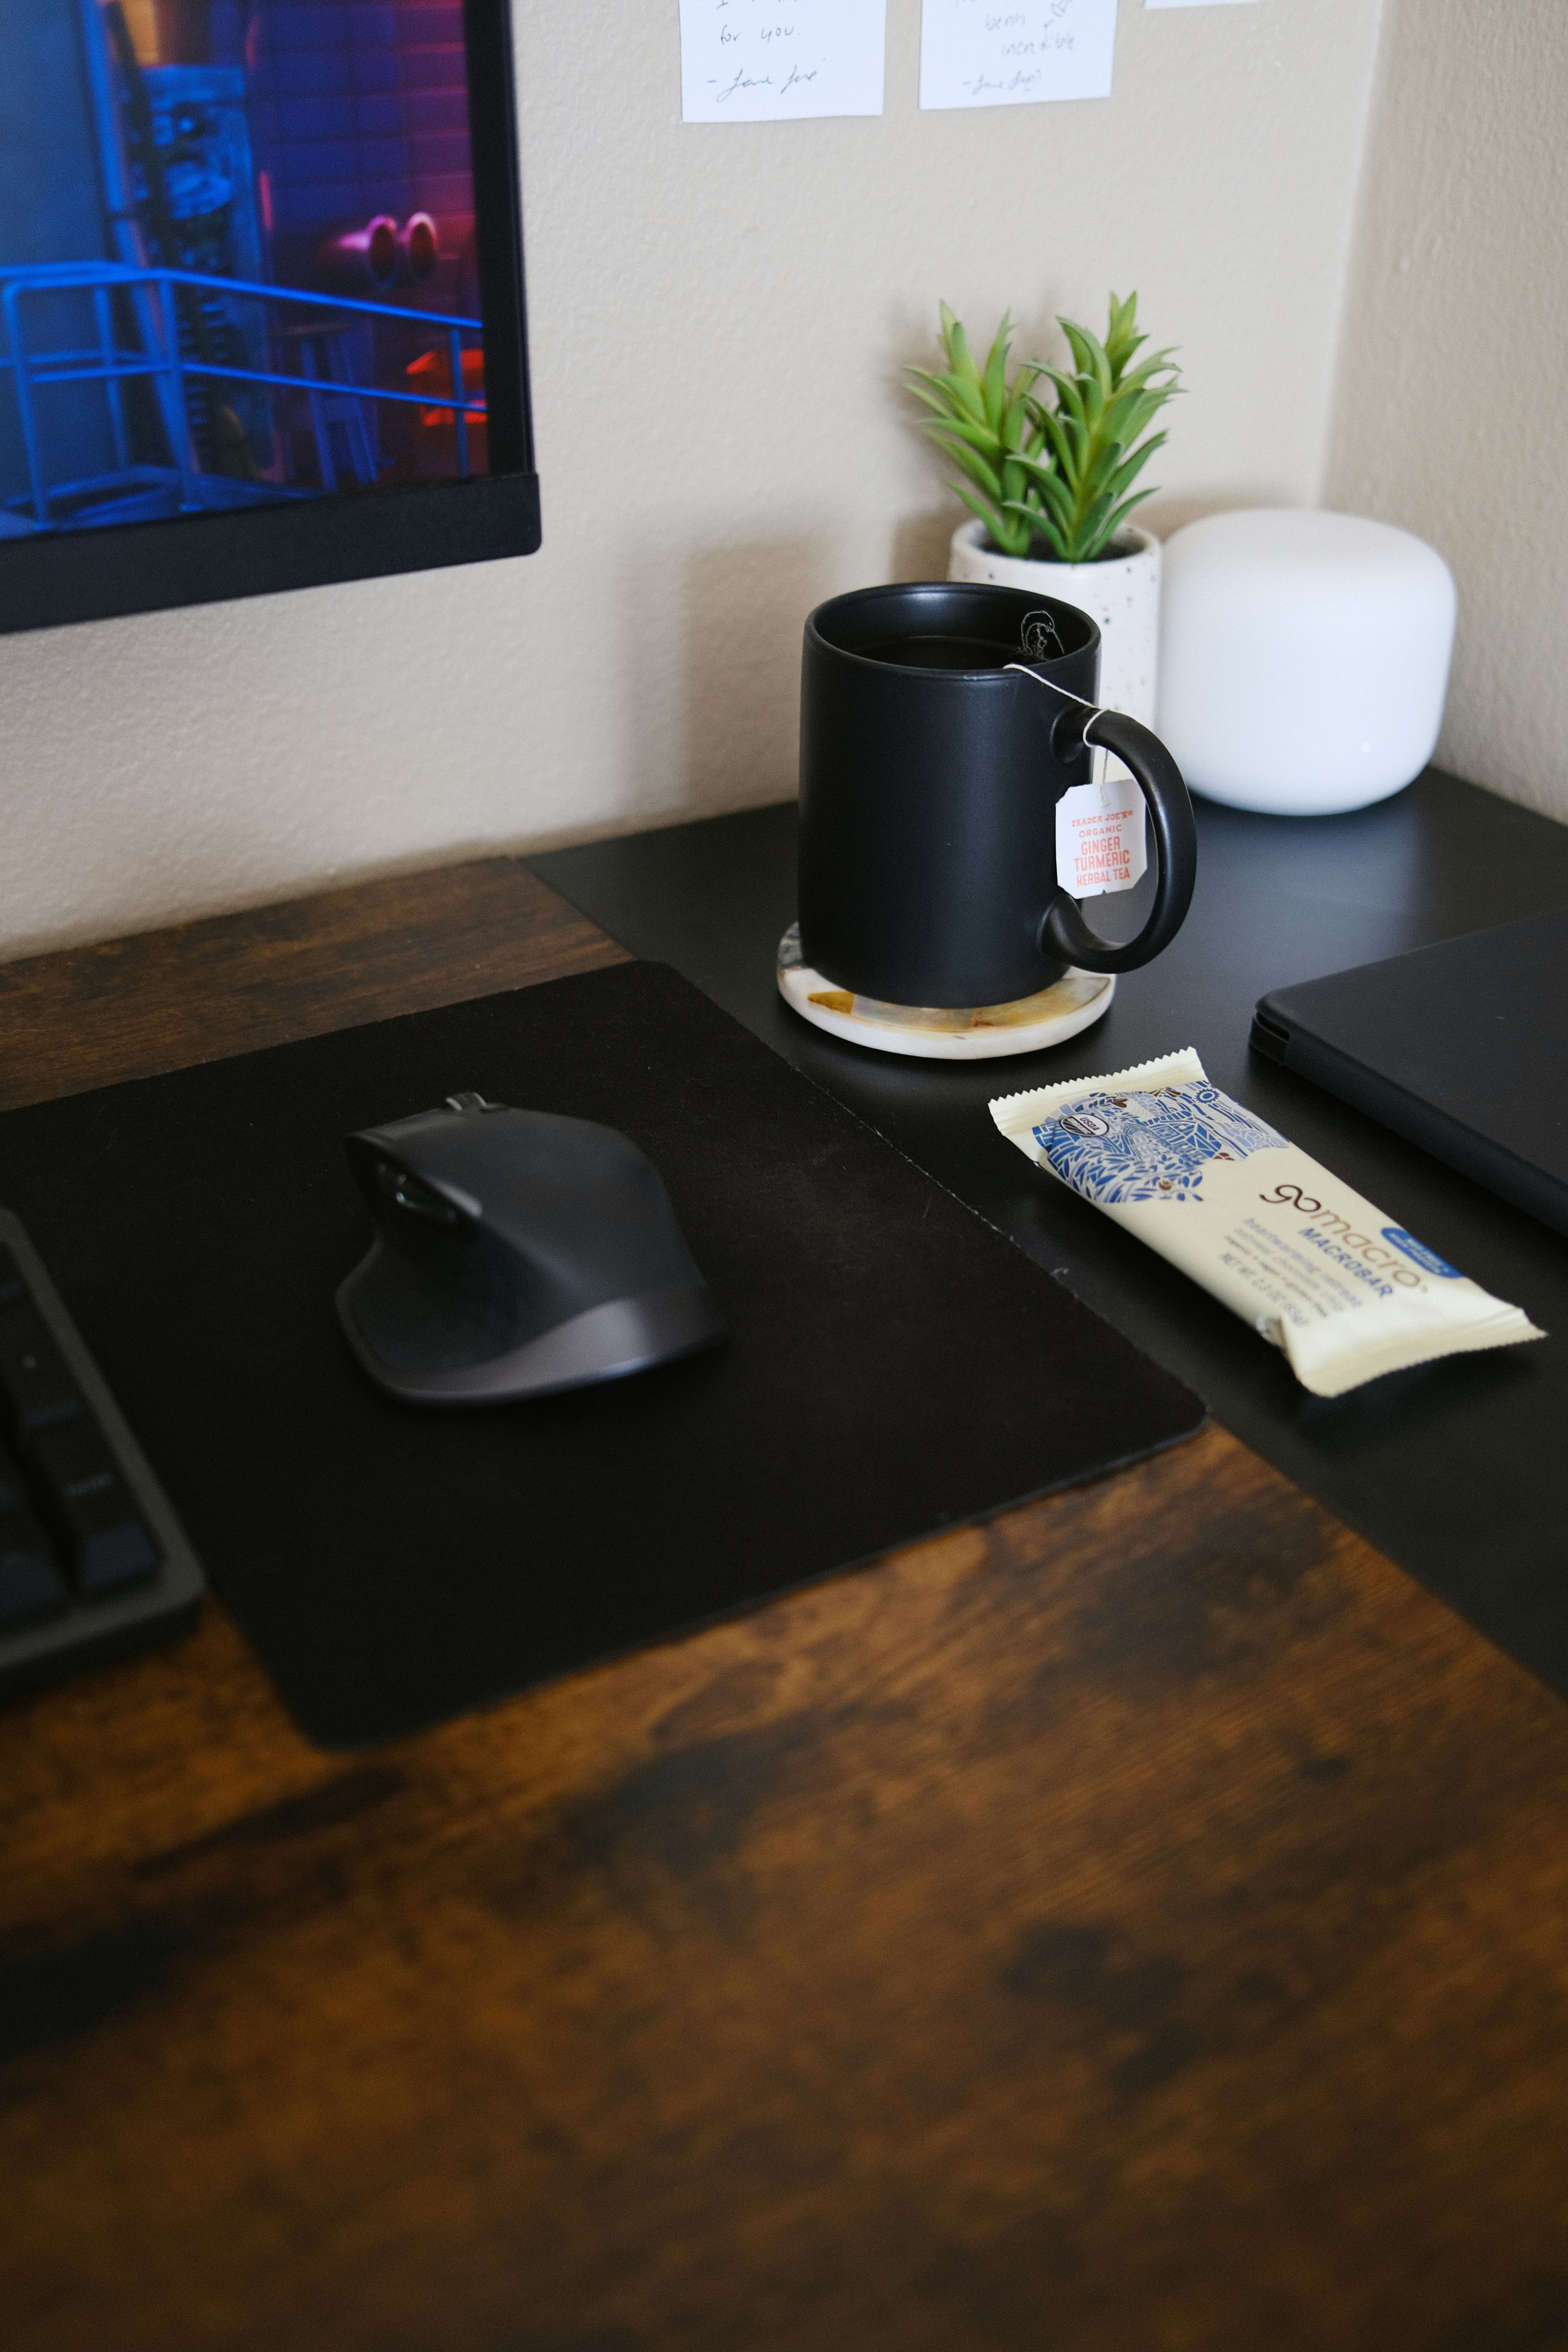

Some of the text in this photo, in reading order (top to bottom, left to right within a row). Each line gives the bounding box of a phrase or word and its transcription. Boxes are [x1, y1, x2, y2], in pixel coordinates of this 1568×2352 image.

[720, 24, 741, 45] for
[1072, 816, 1102, 827] TRADER
[1079, 824, 1122, 838] ORGANIC
[1081, 836, 1121, 856] GINGER
[1074, 850, 1130, 871] TURMERIC
[1076, 867, 1130, 887] HERBAL TEA
[1080, 1117, 1100, 1130] USDA
[1298, 1228, 1393, 1298] MACROBAR
